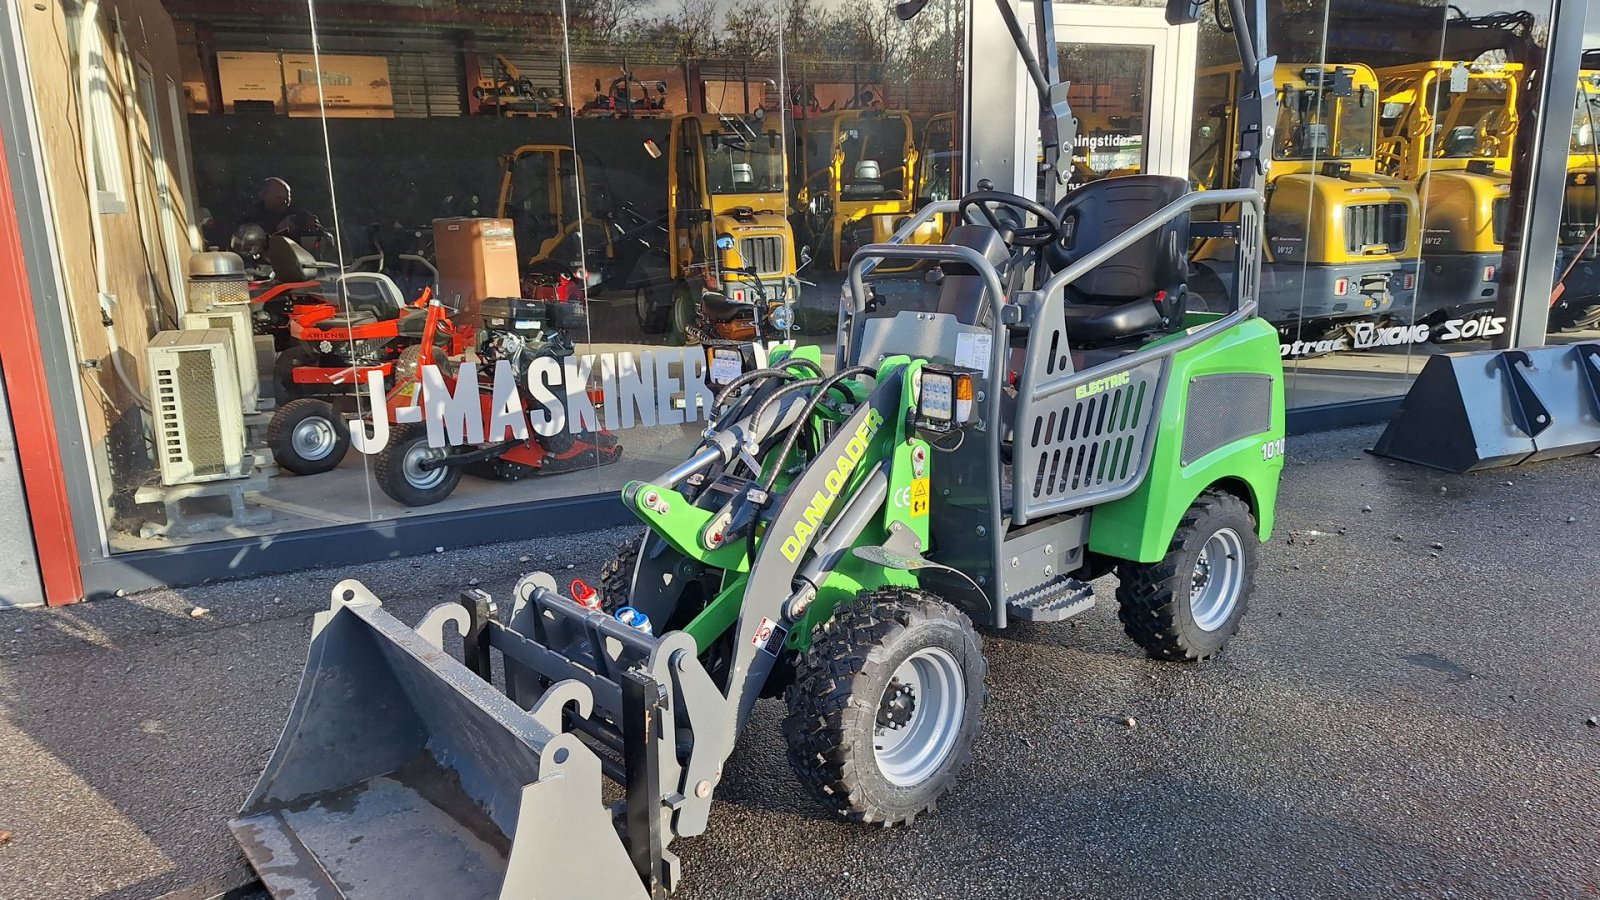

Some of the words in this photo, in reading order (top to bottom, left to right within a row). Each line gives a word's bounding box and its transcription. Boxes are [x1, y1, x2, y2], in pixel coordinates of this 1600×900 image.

[1277, 246, 1294, 254] W12
[1425, 237, 1442, 245] W12
[1375, 325, 1430, 346] XCMG
[1075, 371, 1130, 400] ELECTRIC
[349, 346, 714, 455] J-MASKINER
[1261, 436, 1285, 461] 1010
[779, 407, 884, 563] DANLOADER
